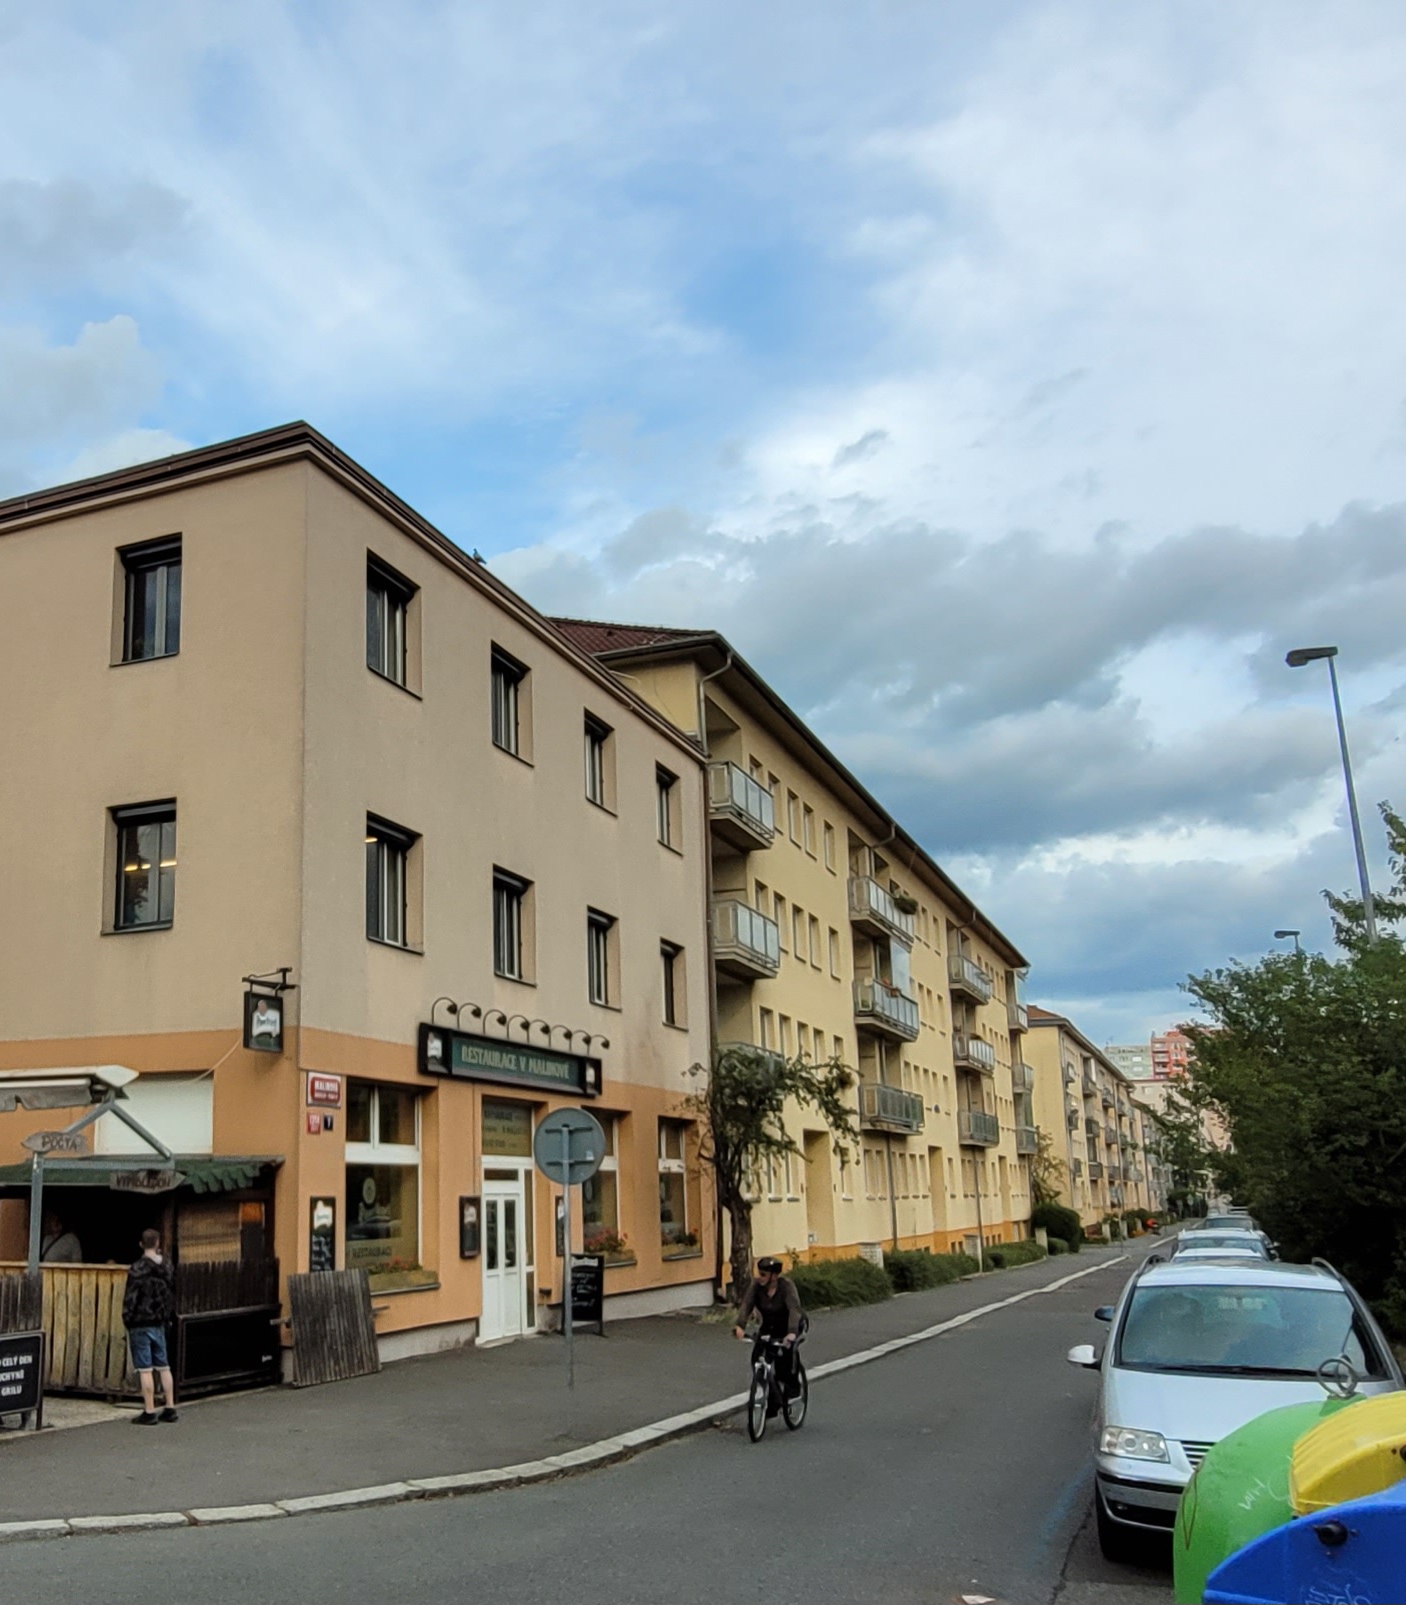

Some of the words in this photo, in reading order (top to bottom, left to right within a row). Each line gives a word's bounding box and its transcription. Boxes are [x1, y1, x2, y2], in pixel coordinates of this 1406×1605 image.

[461, 1044, 517, 1070] RESTAURACE
[519, 1056, 526, 1071] V
[2, 1355, 18, 1367] CELÝ
[19, 1355, 32, 1365] DEN
[1, 1385, 22, 1396] GRILU
